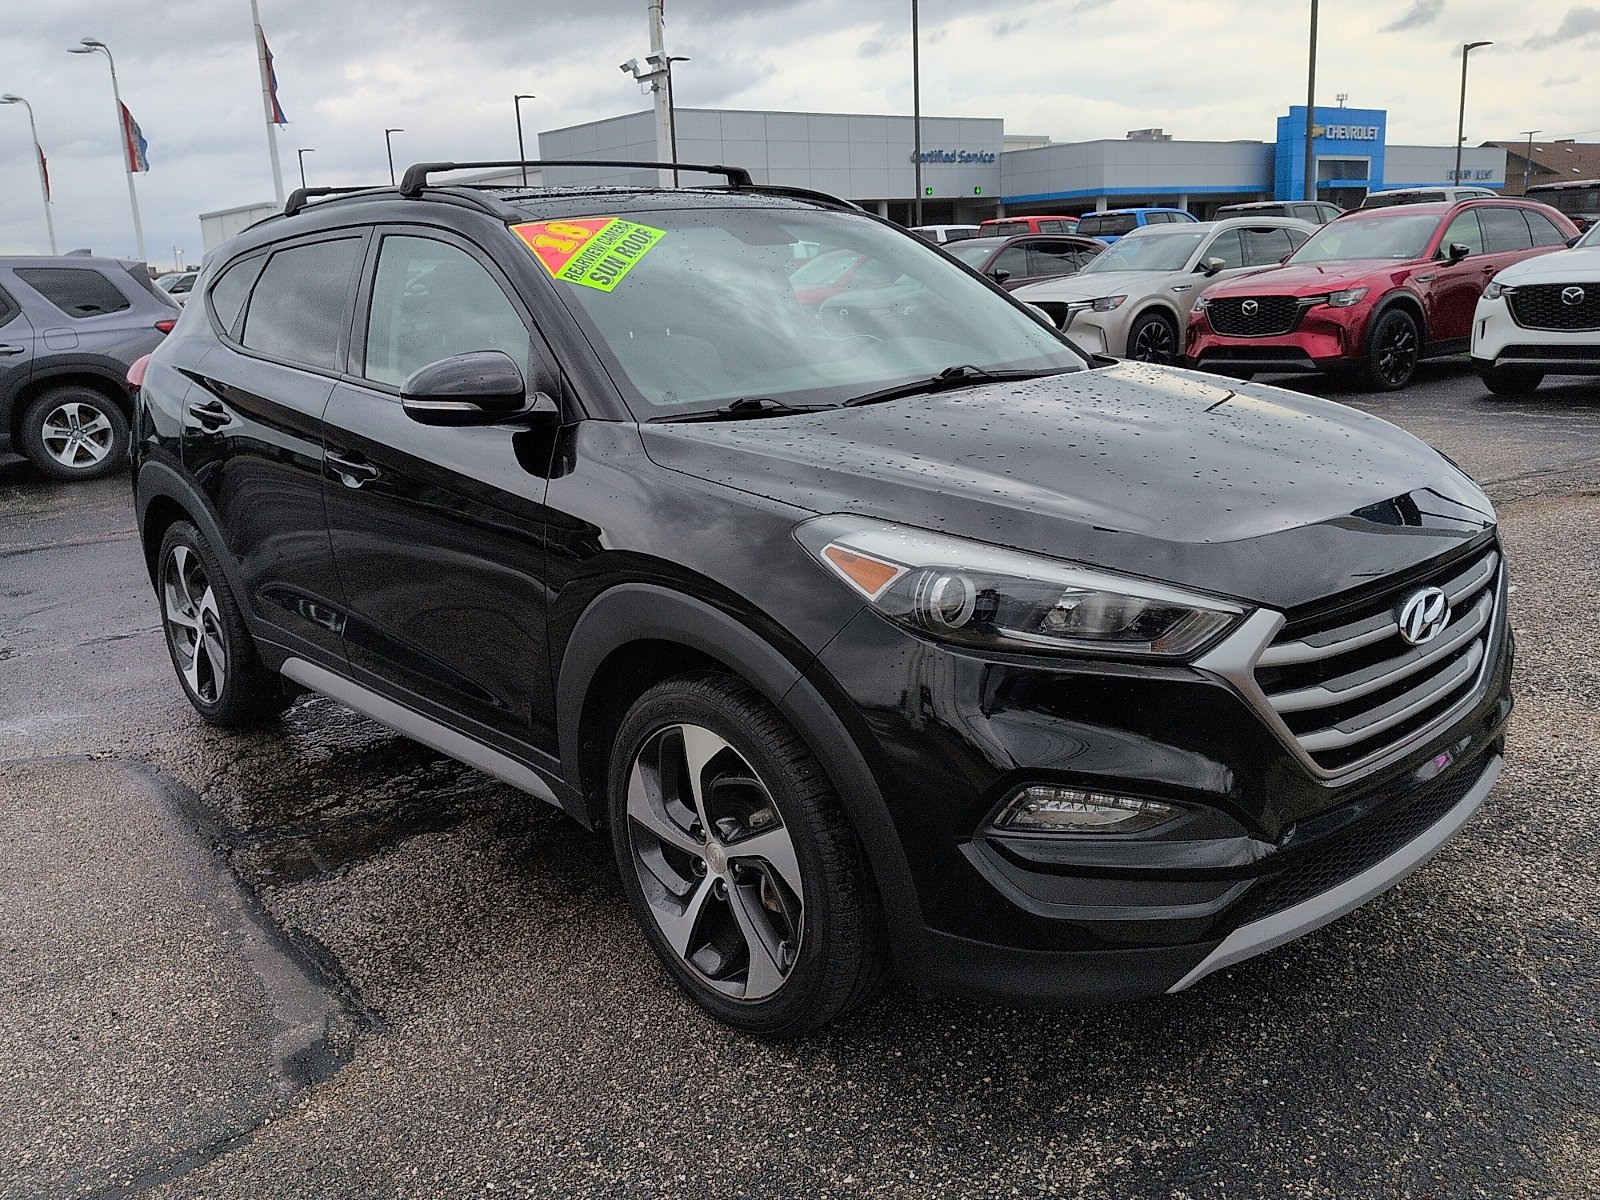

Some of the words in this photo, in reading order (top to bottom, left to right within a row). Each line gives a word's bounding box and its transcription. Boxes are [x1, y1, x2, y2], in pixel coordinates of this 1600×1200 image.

[1326, 125, 1379, 140] CHEVROLET
[958, 150, 995, 163] Service
[531, 222, 592, 254] 18
[562, 242, 608, 281] REARVIEW
[597, 221, 630, 246] CAMERA
[589, 255, 628, 285] SUN
[614, 228, 653, 258] ROOF
